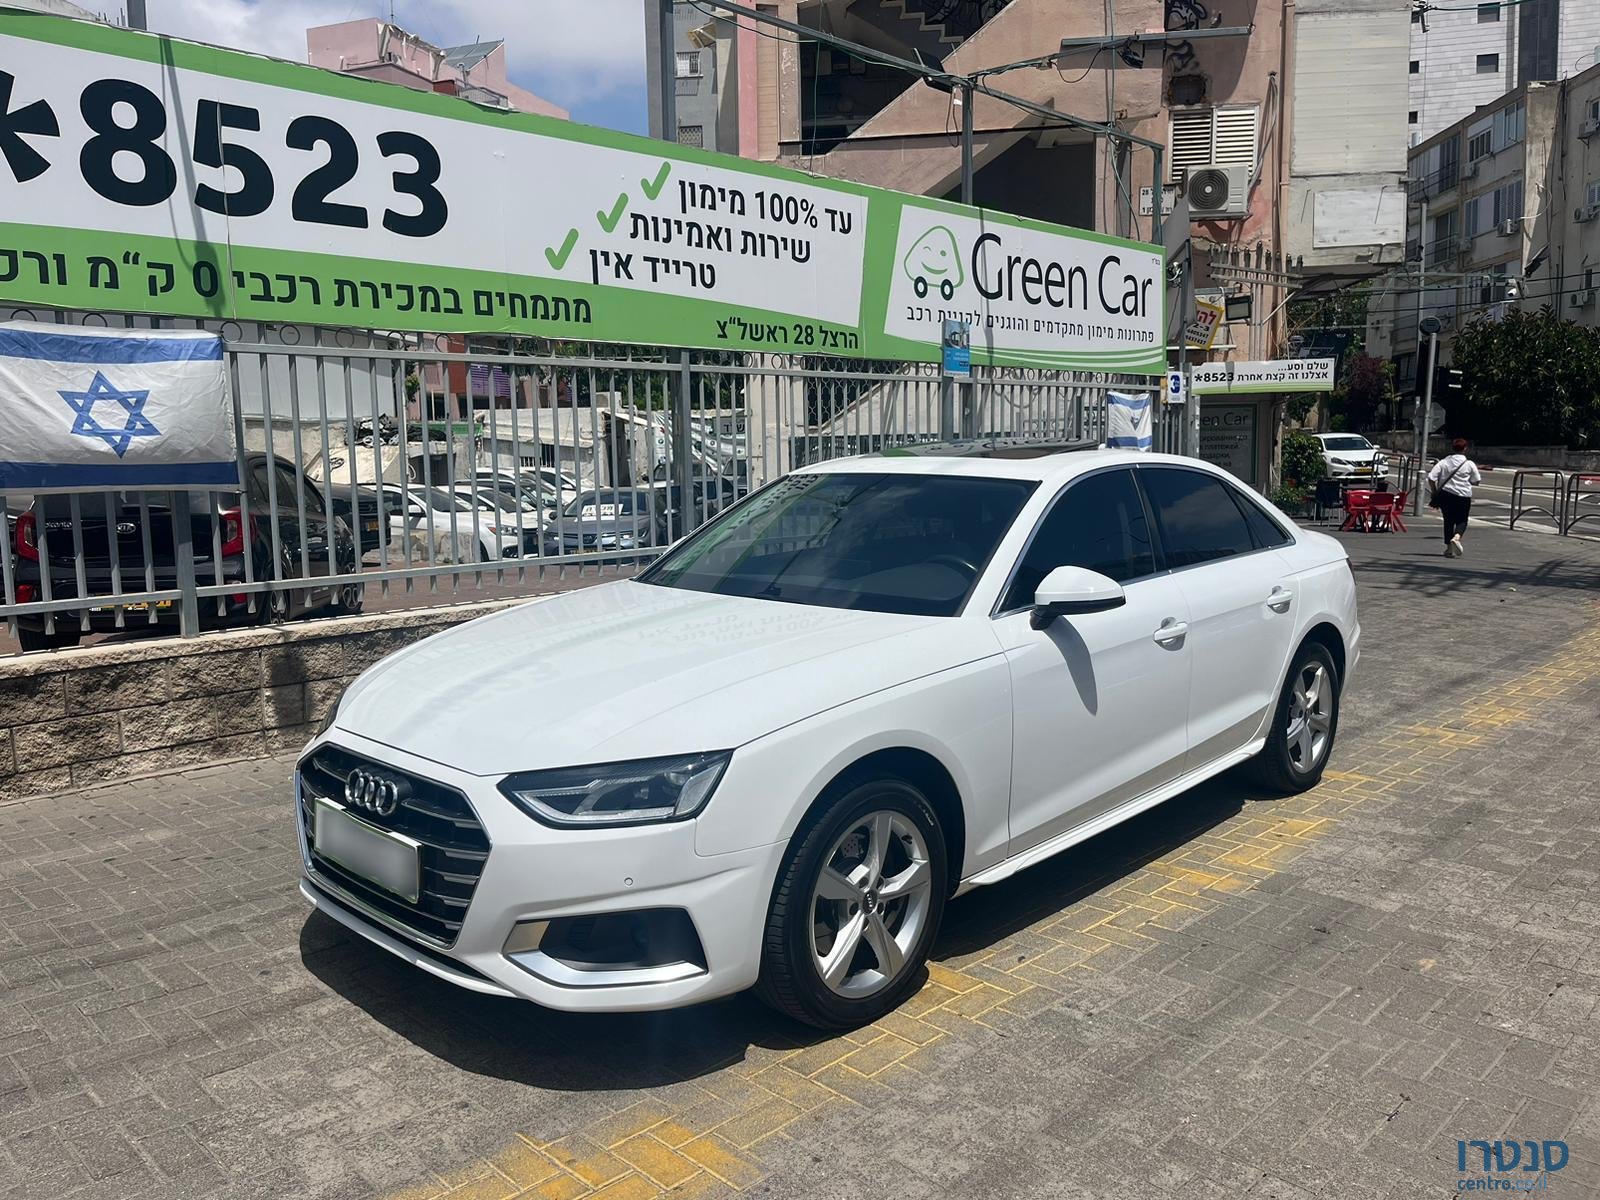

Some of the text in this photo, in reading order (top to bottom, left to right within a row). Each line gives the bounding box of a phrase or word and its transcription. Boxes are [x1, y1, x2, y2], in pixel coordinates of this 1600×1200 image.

[679, 179, 852, 235] עד 100% מימון
[629, 211, 811, 264] שירות ואמינות
[192, 260, 218, 297] 0
[589, 249, 716, 289] טרייד אין
[971, 232, 1153, 318] Green Car
[231, 270, 321, 305] רכבי
[333, 278, 463, 315] במכירת
[473, 289, 592, 323] מתמחים
[907, 306, 932, 323] רכב
[986, 314, 1029, 331] והוגנים
[1034, 319, 1083, 339] מתקדמים
[1087, 324, 1114, 341] מימון
[793, 323, 814, 346] 28
[819, 325, 858, 350] הרצל
[1117, 328, 1154, 343] פתרונות
[1288, 371, 1299, 380] זה
[1301, 371, 1328, 380] אצלנו
[1306, 361, 1329, 371] שלם
[1237, 373, 1263, 382] אחרת
[1264, 372, 1286, 382] קצת
